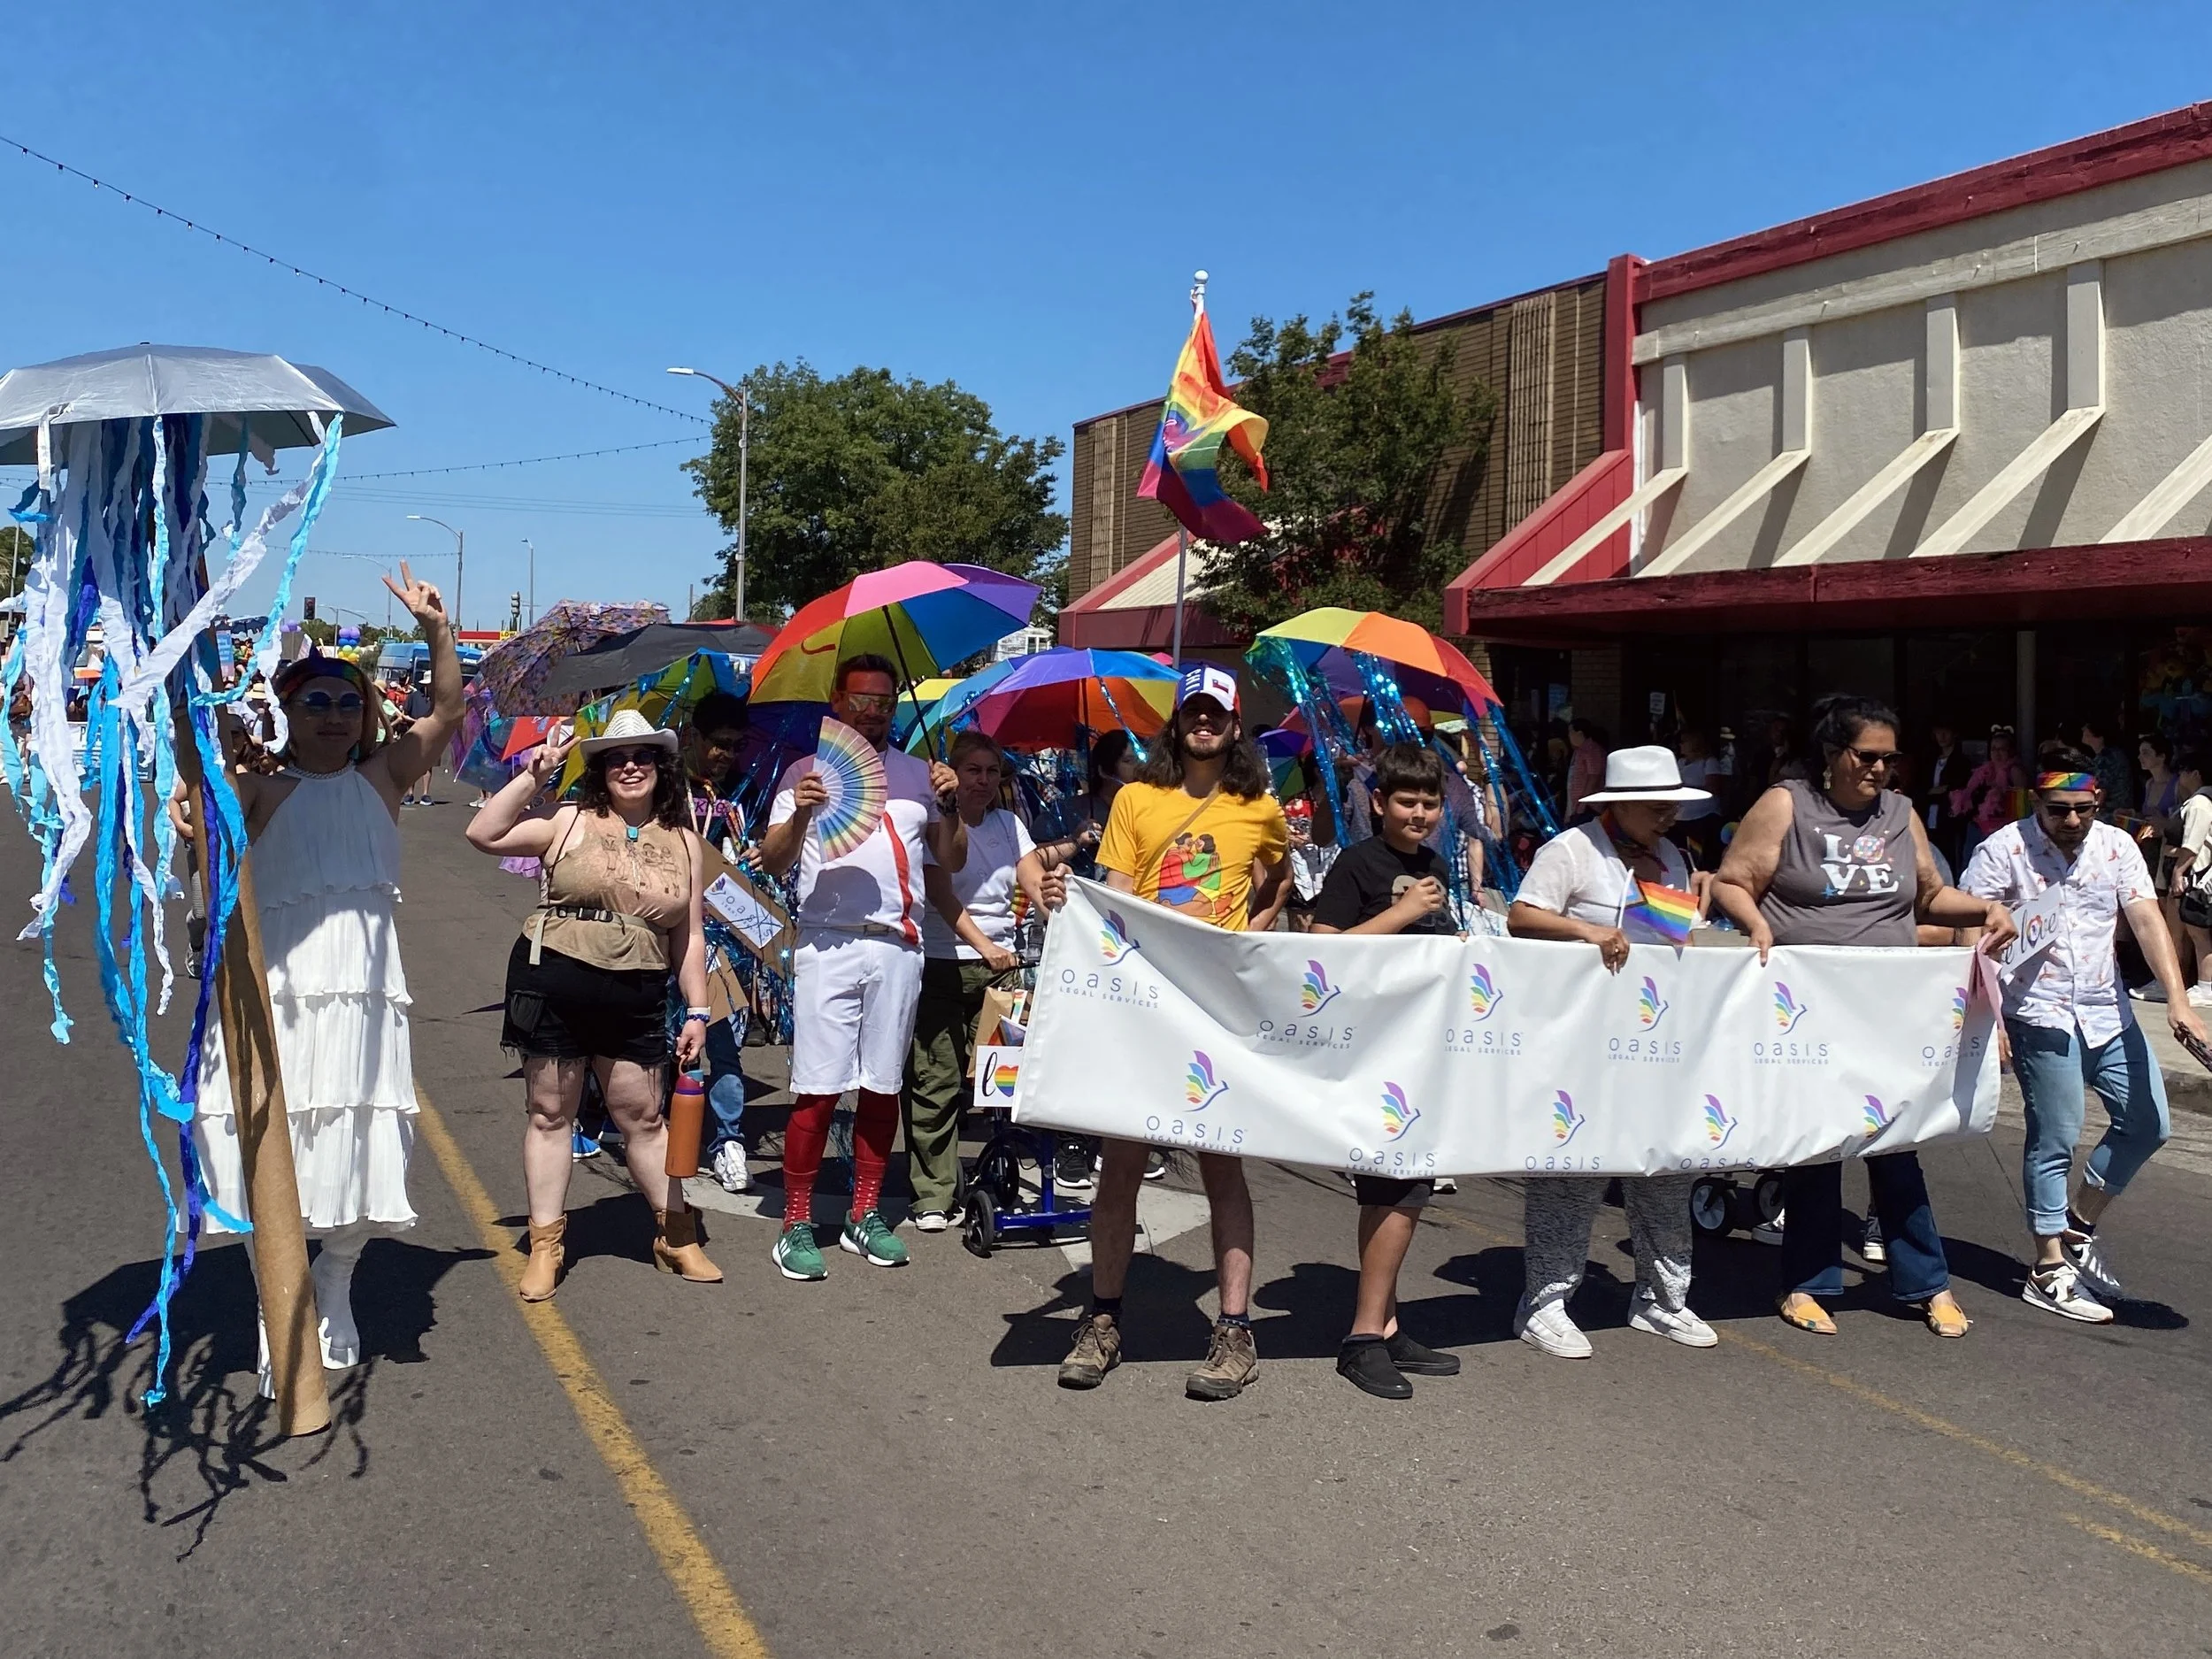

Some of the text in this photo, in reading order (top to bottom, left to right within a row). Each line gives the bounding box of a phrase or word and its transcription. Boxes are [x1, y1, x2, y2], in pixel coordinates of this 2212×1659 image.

[1062, 969, 1158, 999] oasis
[1059, 987, 1158, 1009] LEGAL SERVICES
[1260, 1020, 1353, 1041] oasis
[1446, 1028, 1521, 1047] oasis
[1256, 1032, 1350, 1049] LEGAL SERVICES
[1609, 1037, 1681, 1055] oasis
[1754, 1042, 1828, 1056] oasis
[1146, 1116, 1243, 1144] oasis
[1349, 1148, 1435, 1167] oasis
[1525, 1156, 1600, 1170] oasis
